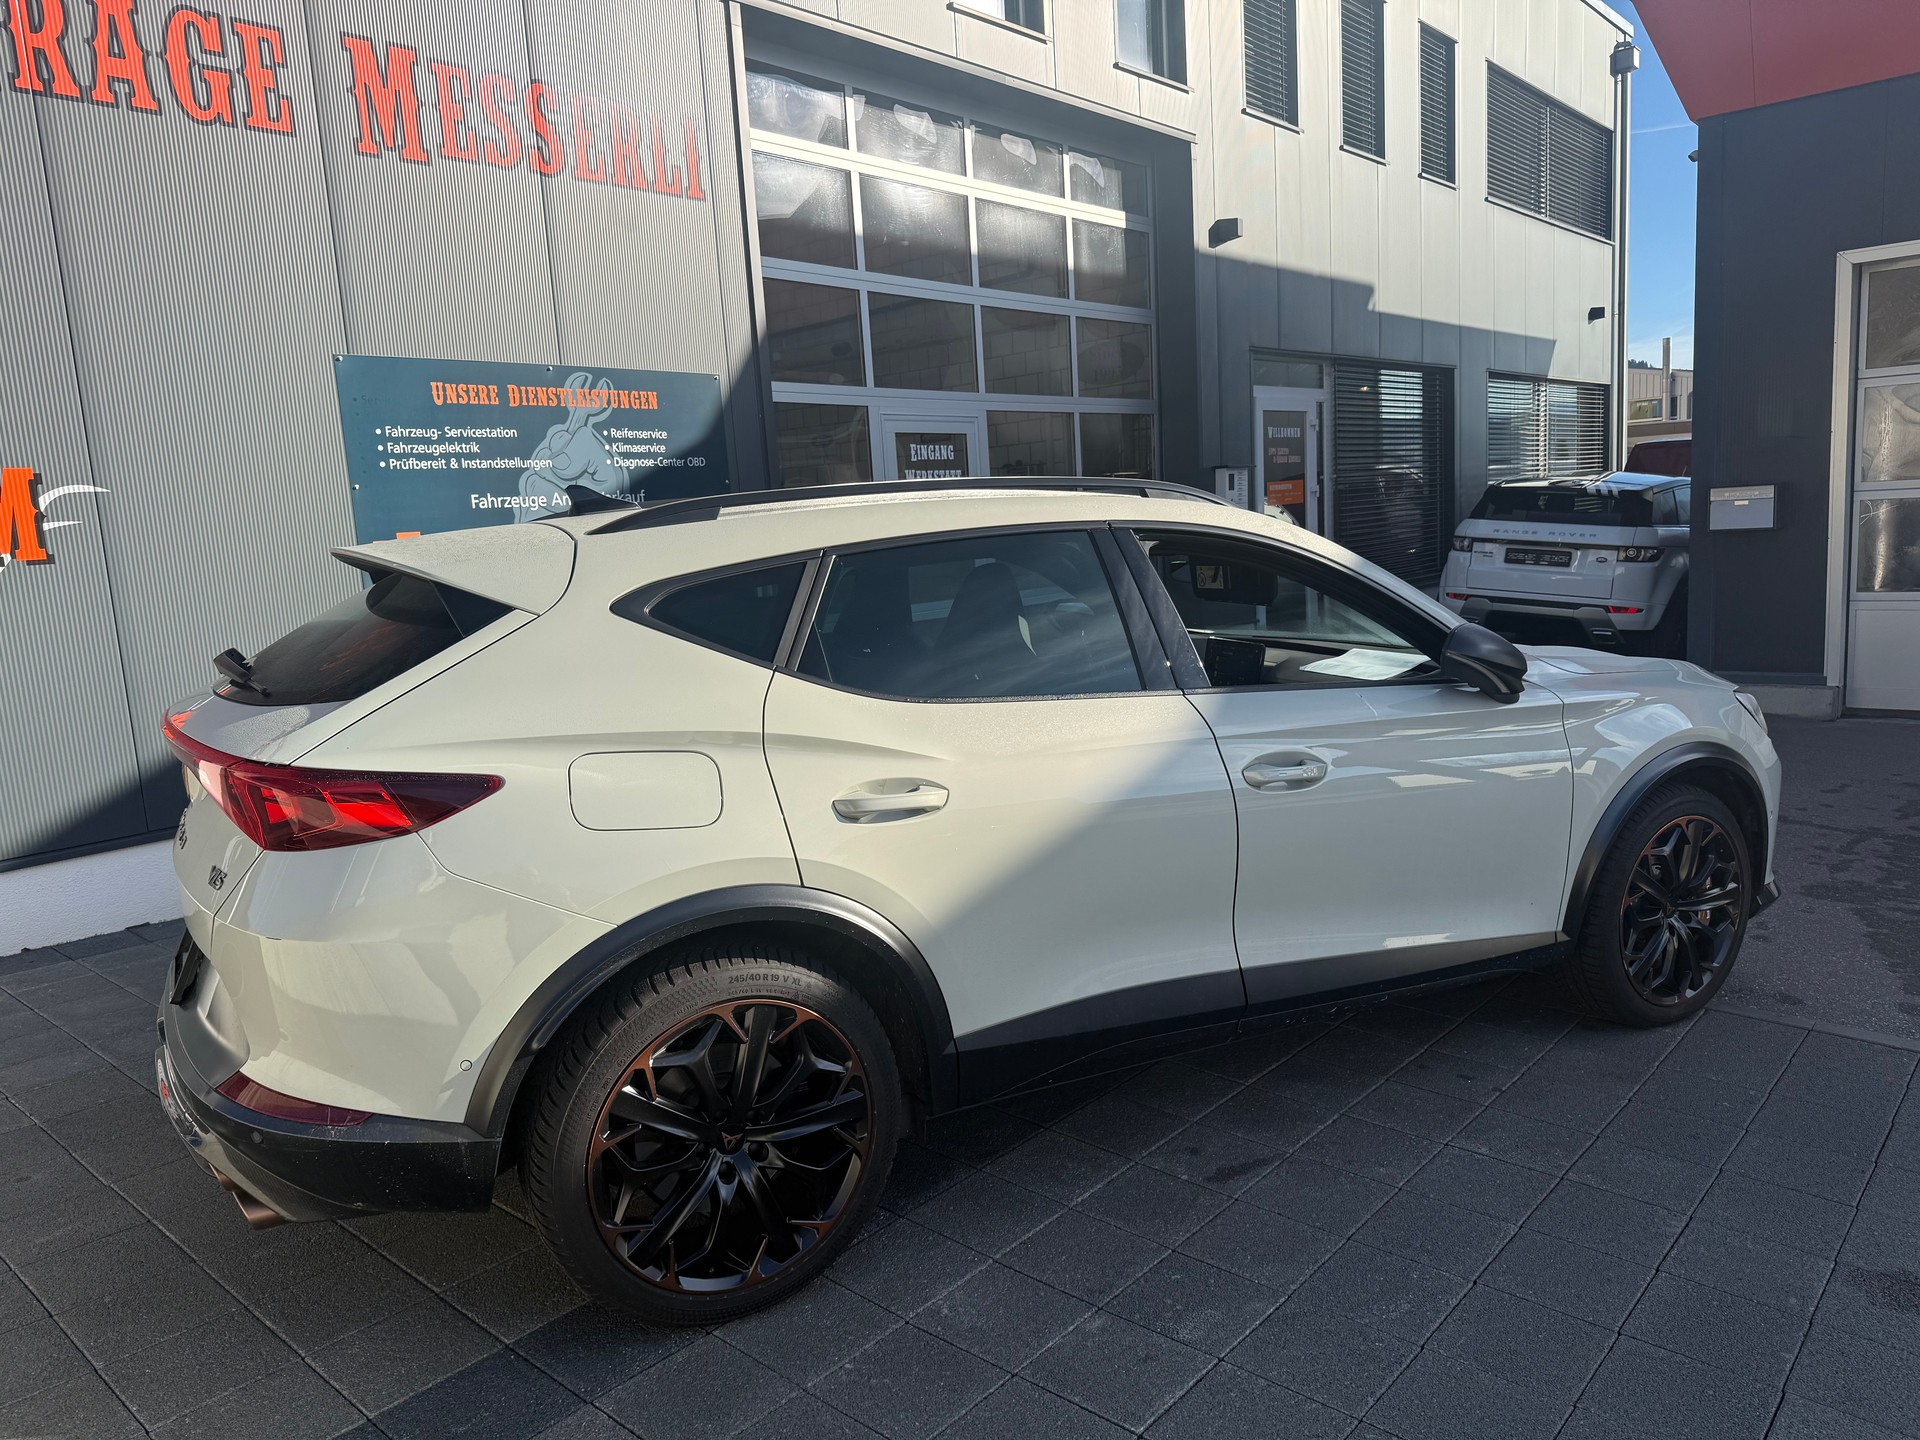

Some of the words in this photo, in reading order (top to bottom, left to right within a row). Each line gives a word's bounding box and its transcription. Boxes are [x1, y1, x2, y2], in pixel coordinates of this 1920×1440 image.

[341, 34, 706, 201] MESSERLI
[430, 381, 499, 406] UNSERE
[507, 384, 658, 410] DIENSTLEISTUNGEN
[385, 426, 442, 440] Fahrzeug-
[444, 426, 518, 438] Servicestation
[610, 428, 668, 439] Reifenservice
[387, 442, 481, 456] Fahrzeugelektrik
[612, 443, 667, 454] Klimaservice
[910, 444, 955, 462] EINGANG
[389, 458, 447, 470] Prüfbereit
[450, 459, 459, 469] &
[461, 457, 553, 471] Instandstellungen
[614, 457, 685, 470] Diagnose-Center
[687, 458, 706, 467] OBD
[471, 493, 547, 511] Fahrzeuge
[728, 973, 761, 985] 245/40
[770, 973, 780, 982] 19
